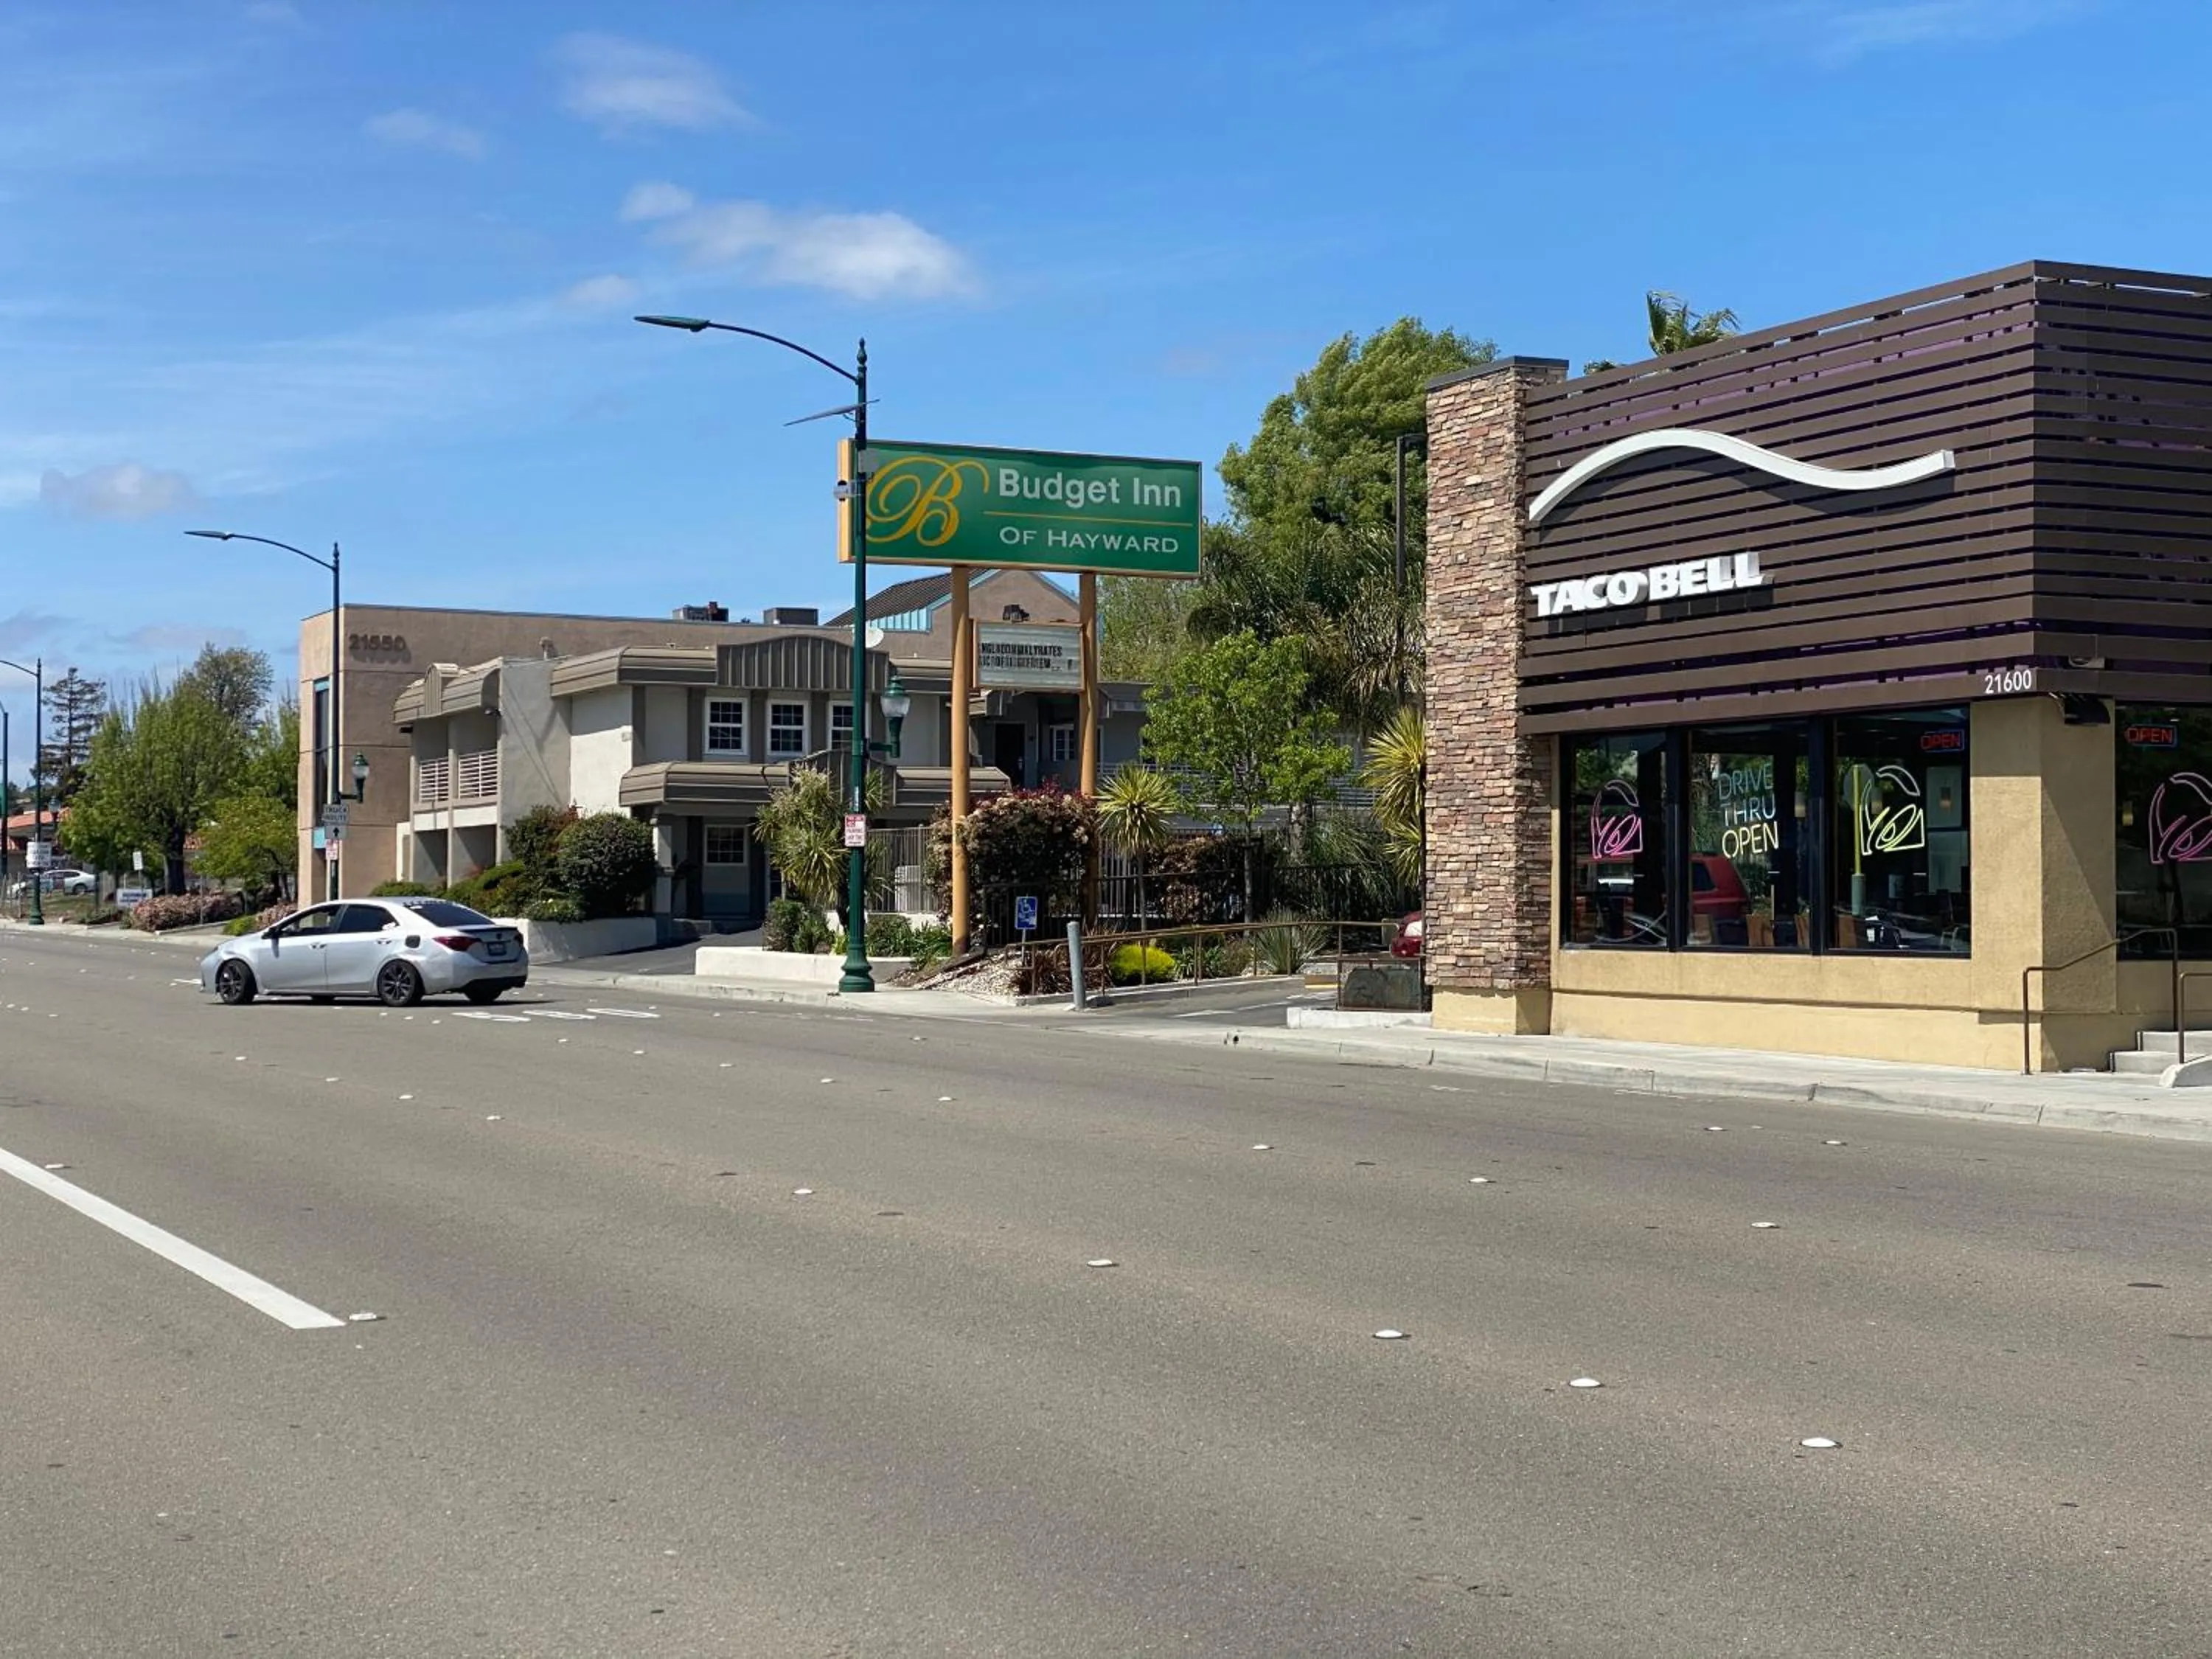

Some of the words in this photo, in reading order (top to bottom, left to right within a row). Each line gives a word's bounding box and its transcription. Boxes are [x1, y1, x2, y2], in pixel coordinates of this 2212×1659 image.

[999, 468, 1120, 509] Budget
[1133, 477, 1181, 508] Inn
[999, 526, 1037, 545] OF
[1048, 529, 1179, 554] HAYWARD
[1530, 571, 1649, 617] TACO
[1649, 551, 1766, 602] BELL
[349, 634, 407, 653] 21550
[1984, 669, 2032, 695] 21600
[1921, 733, 1961, 750] OPEN
[2125, 727, 2173, 744] OPEN
[1719, 762, 1774, 800] DRIVE
[1720, 793, 1776, 827] THRU
[1722, 821, 1779, 859] OPEN
